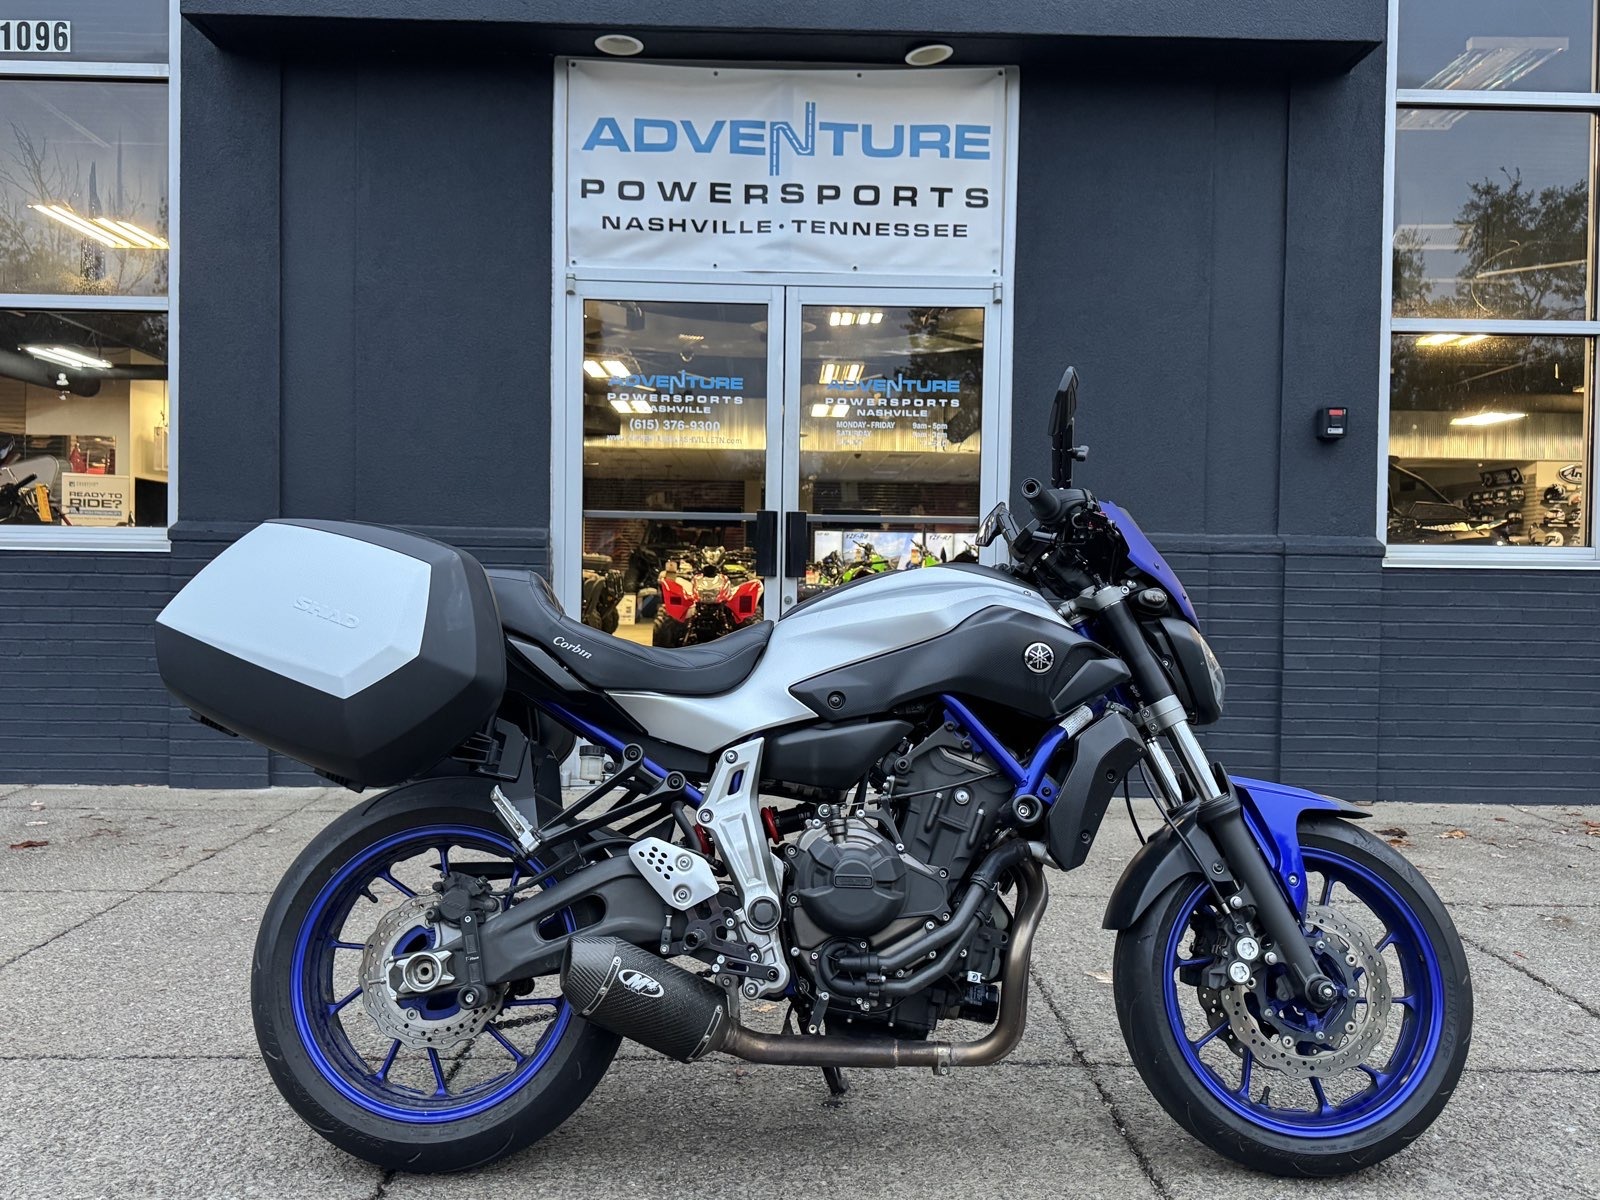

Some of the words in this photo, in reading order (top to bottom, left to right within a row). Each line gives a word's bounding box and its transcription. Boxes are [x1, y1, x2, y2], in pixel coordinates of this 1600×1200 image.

[0, 21, 68, 51] 1096
[581, 101, 991, 176] ADVENTURE
[580, 178, 990, 209] POWERSPORTS
[601, 215, 773, 234] NASHVILLE
[791, 219, 968, 238] TENNESSEE
[607, 370, 743, 394] ADVENTURE
[827, 373, 960, 398] ADVENTURE
[607, 393, 743, 404] POWERSPORTS
[641, 405, 711, 414] ASHVILLE
[825, 397, 960, 408] POWERSPORTS
[856, 408, 928, 417] NASHVILLE
[629, 418, 659, 432] (615)
[663, 420, 720, 431] 376-9300
[69, 491, 106, 499] READY
[69, 498, 123, 509] RIDE?
[293, 597, 360, 629] SHAD
[553, 636, 593, 660] Corbin
